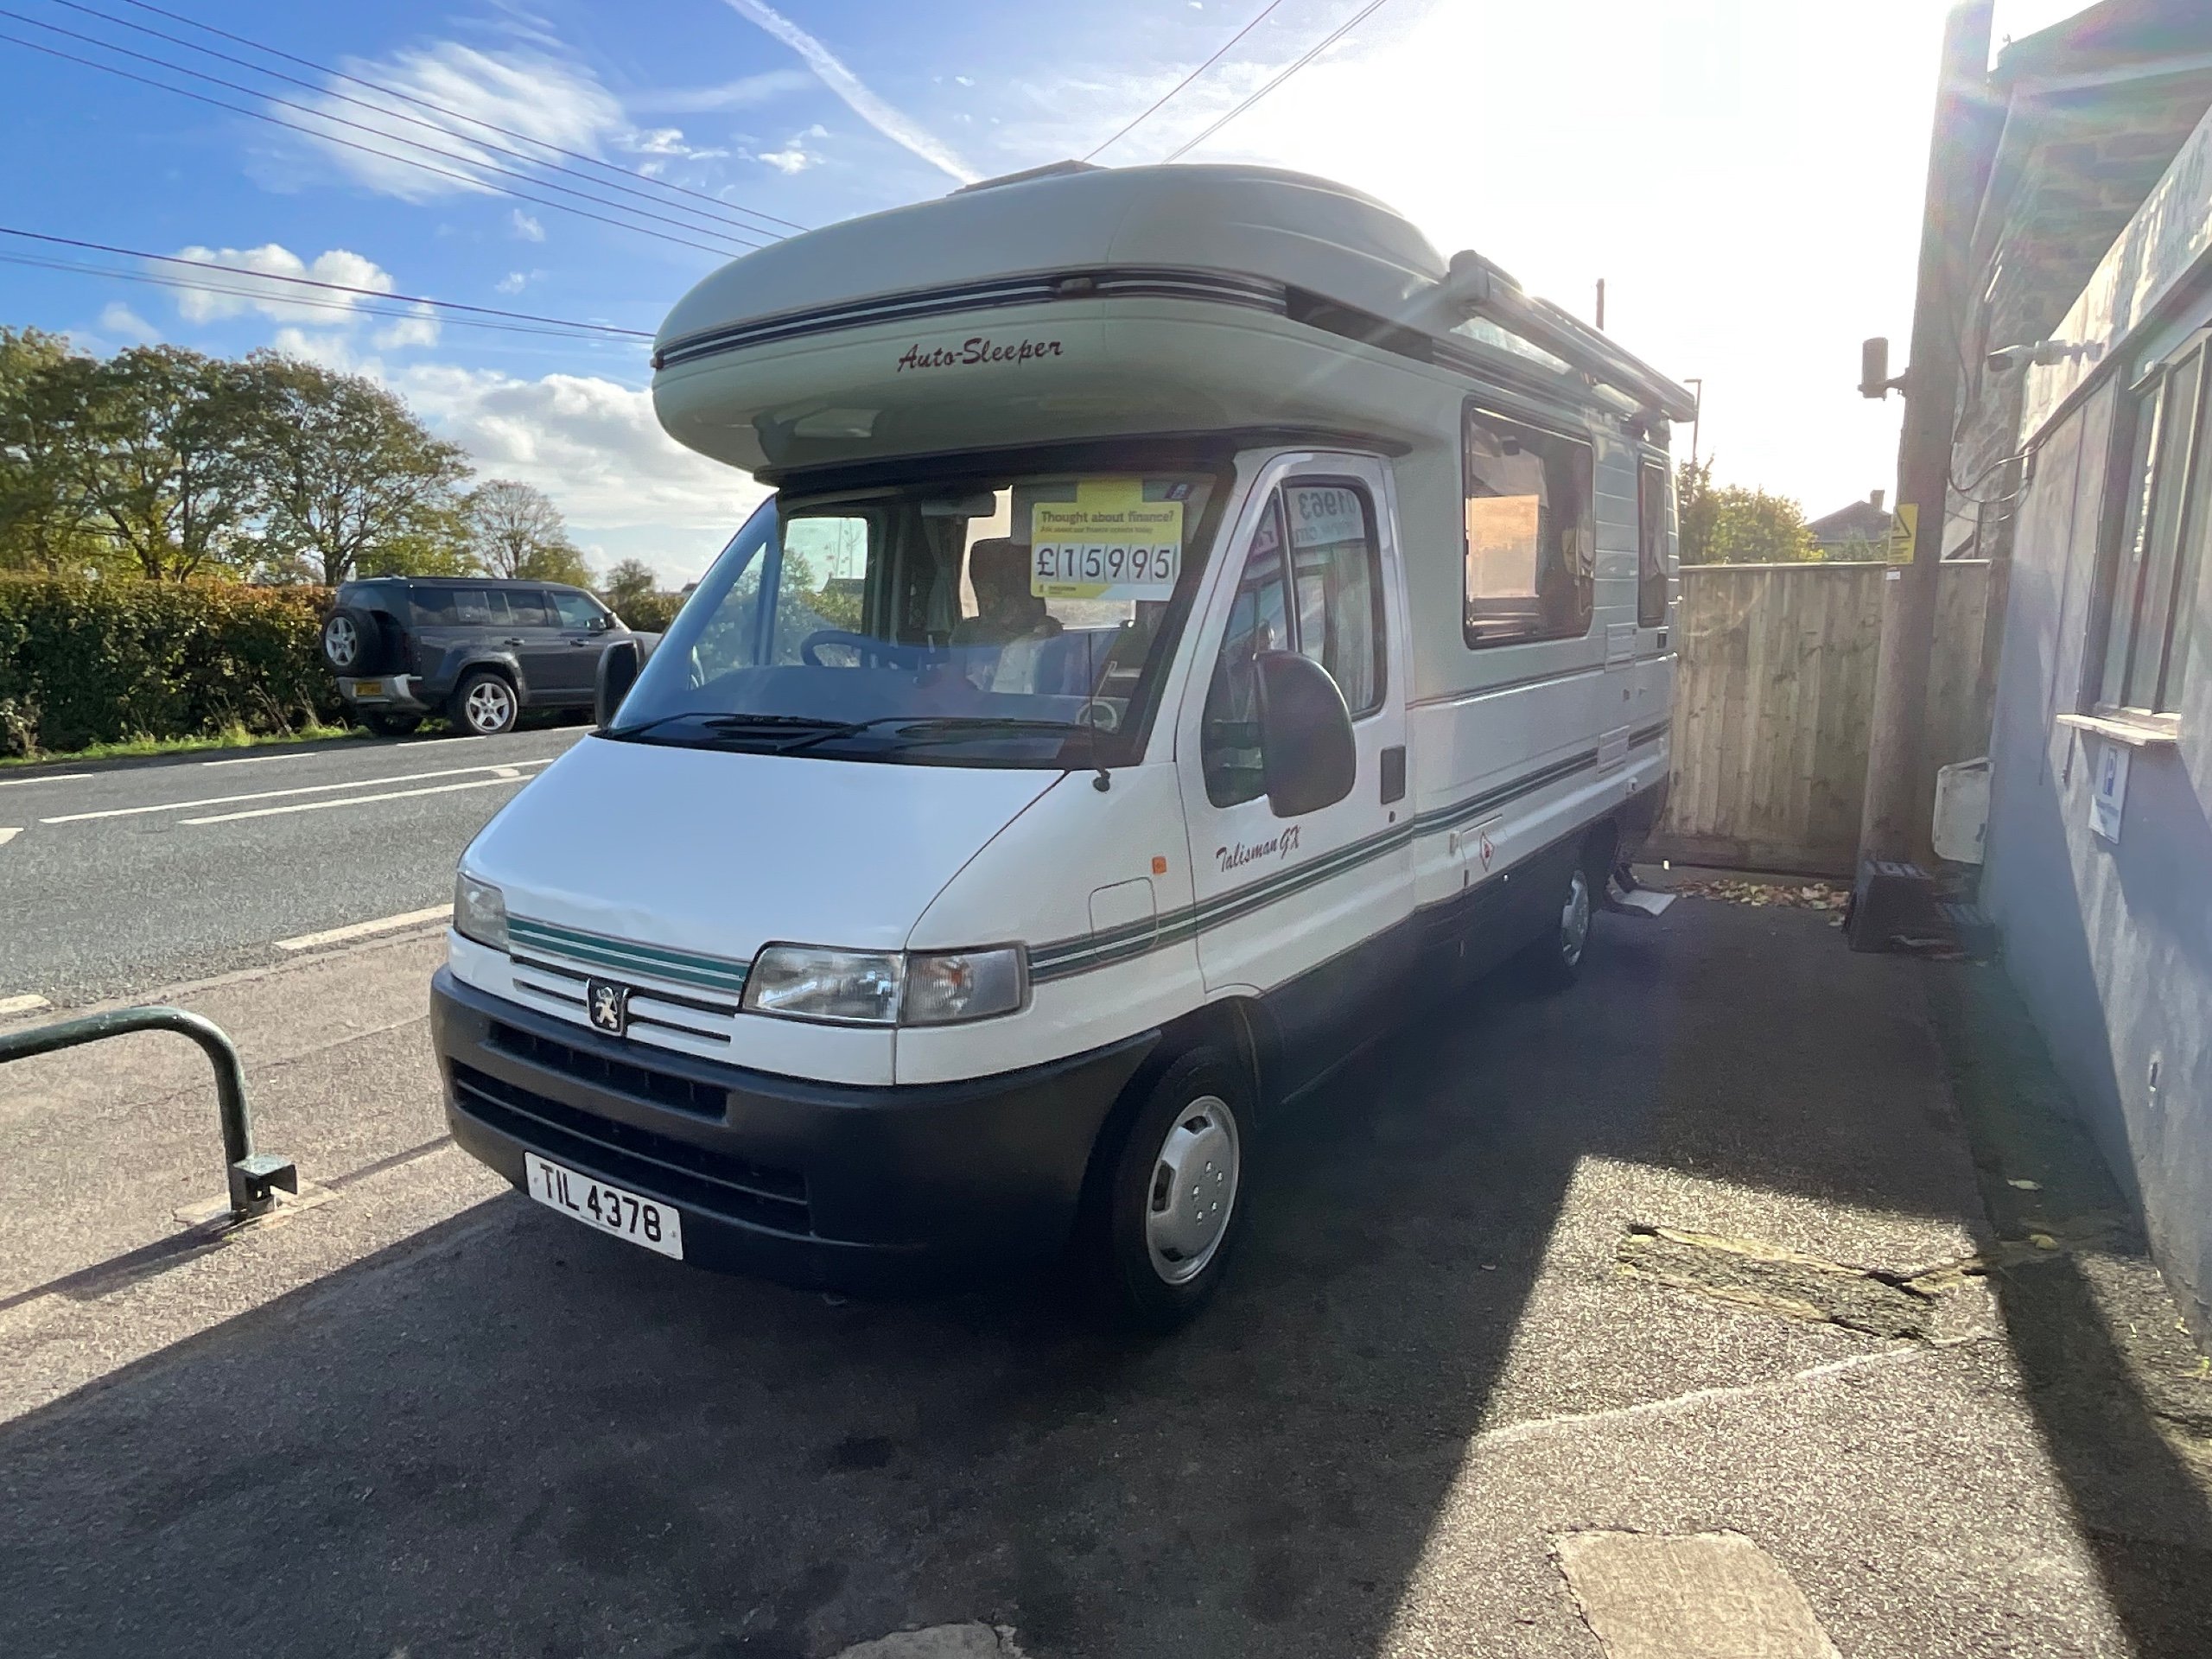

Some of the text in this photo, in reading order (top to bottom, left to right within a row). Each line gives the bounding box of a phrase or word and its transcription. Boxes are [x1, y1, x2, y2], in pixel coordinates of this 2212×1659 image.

[897, 338, 1063, 372] Auto-Sleeper
[1041, 510, 1174, 524] Thought about finance?
[1037, 548, 1170, 579] £15995
[1216, 824, 1301, 873] Talisman GX
[540, 1163, 662, 1243] TIL 4378
